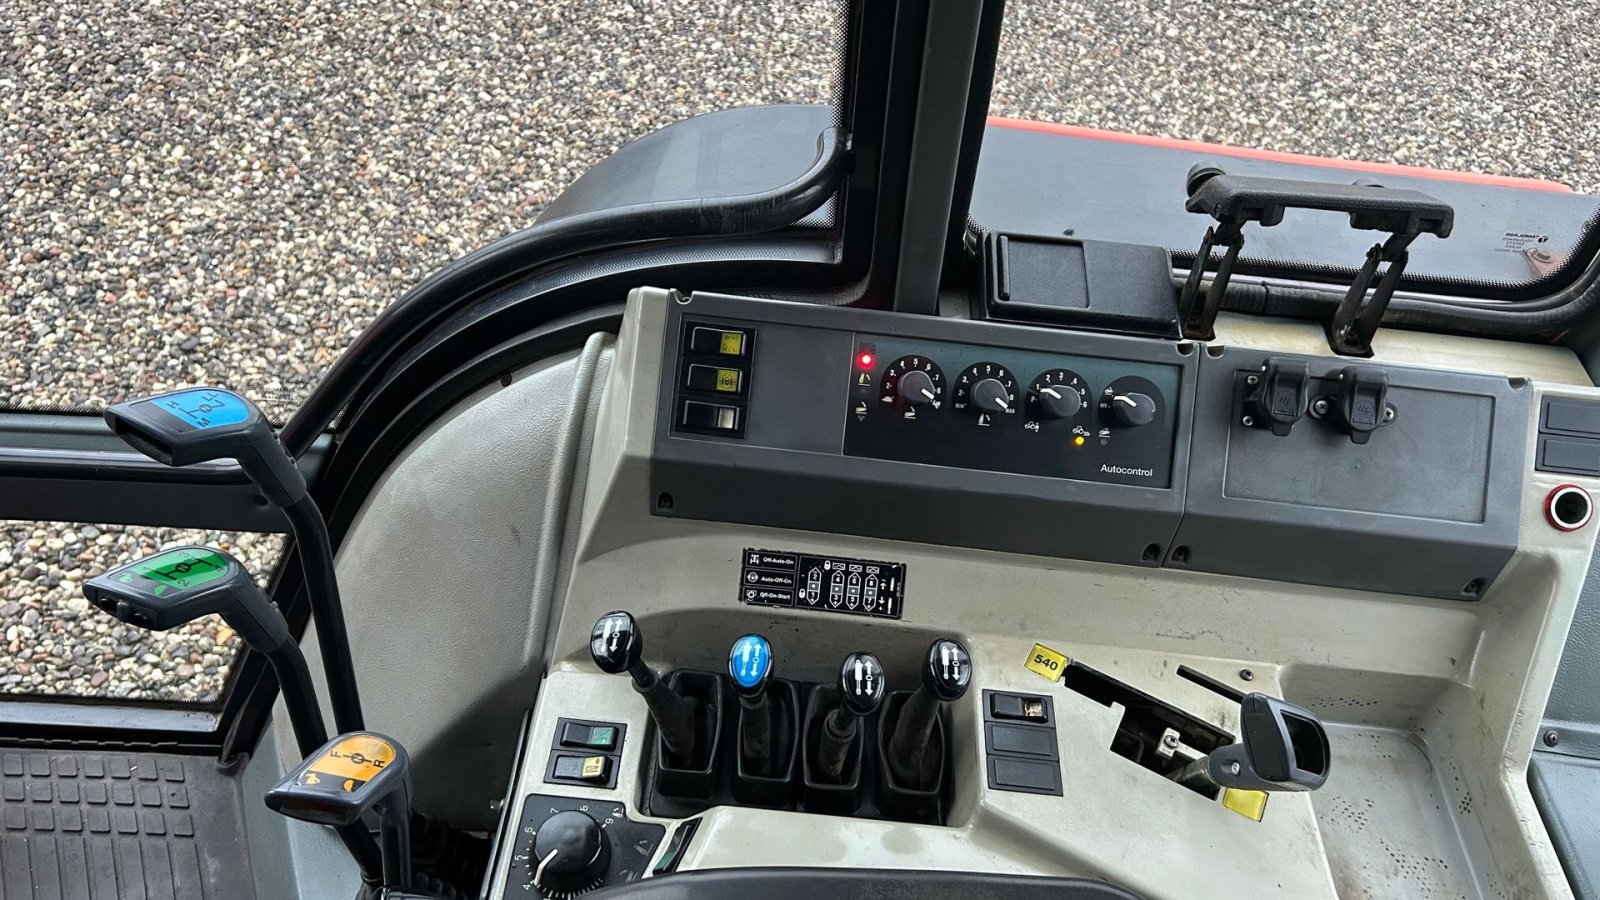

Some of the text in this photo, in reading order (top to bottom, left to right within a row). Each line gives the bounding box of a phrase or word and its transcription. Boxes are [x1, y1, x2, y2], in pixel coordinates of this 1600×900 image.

[1072, 377, 1078, 385] 4
[166, 400, 180, 408] H
[1100, 464, 1153, 477] Autocontrol
[763, 556, 794, 565] Off-Auto-On
[178, 578, 190, 588] 2
[760, 576, 792, 584] Auto-Off-On
[1033, 654, 1058, 672] 540
[372, 760, 385, 768] R
